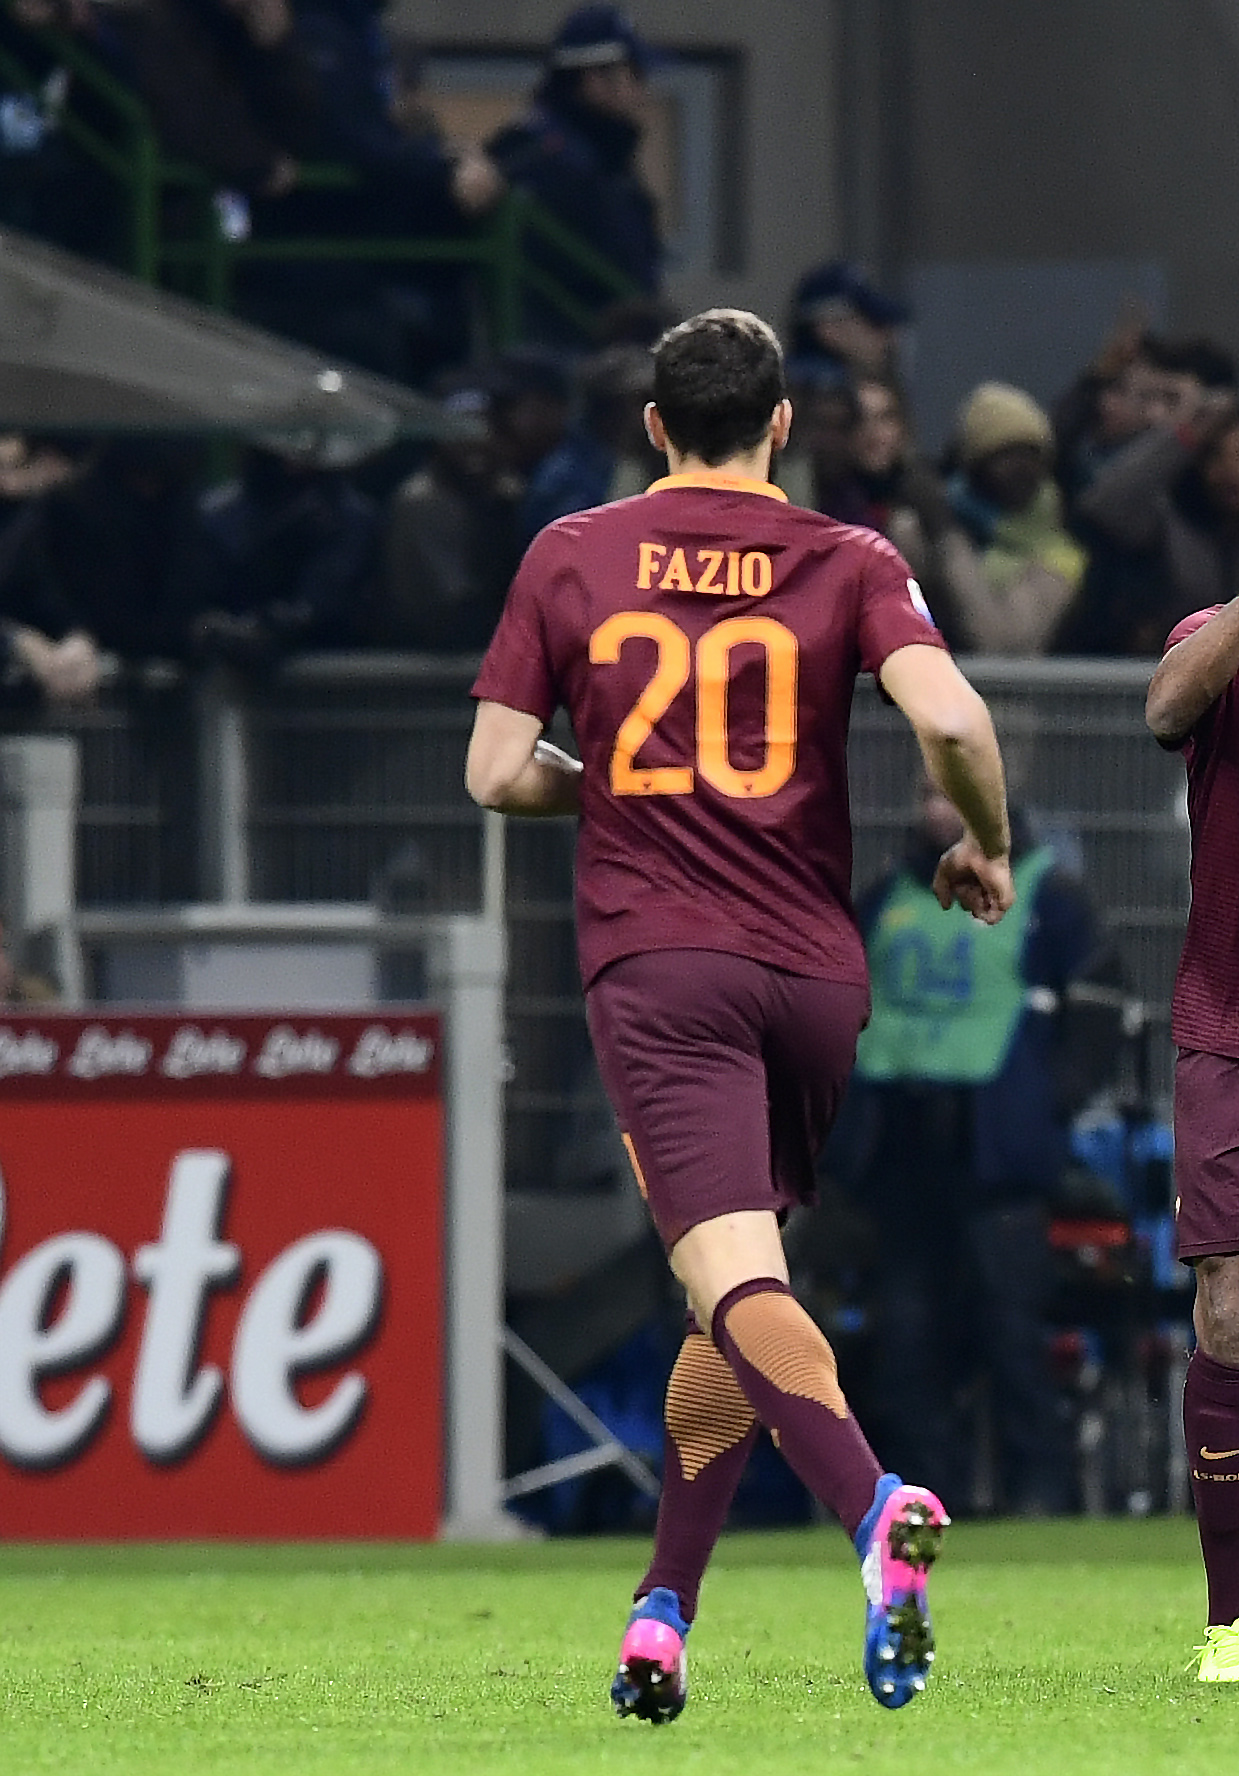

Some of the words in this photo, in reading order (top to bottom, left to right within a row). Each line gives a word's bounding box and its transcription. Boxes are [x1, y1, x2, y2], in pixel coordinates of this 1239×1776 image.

[636, 541, 772, 598] FAZIO
[588, 610, 800, 799] 20
[0, 1147, 384, 1460] ete
